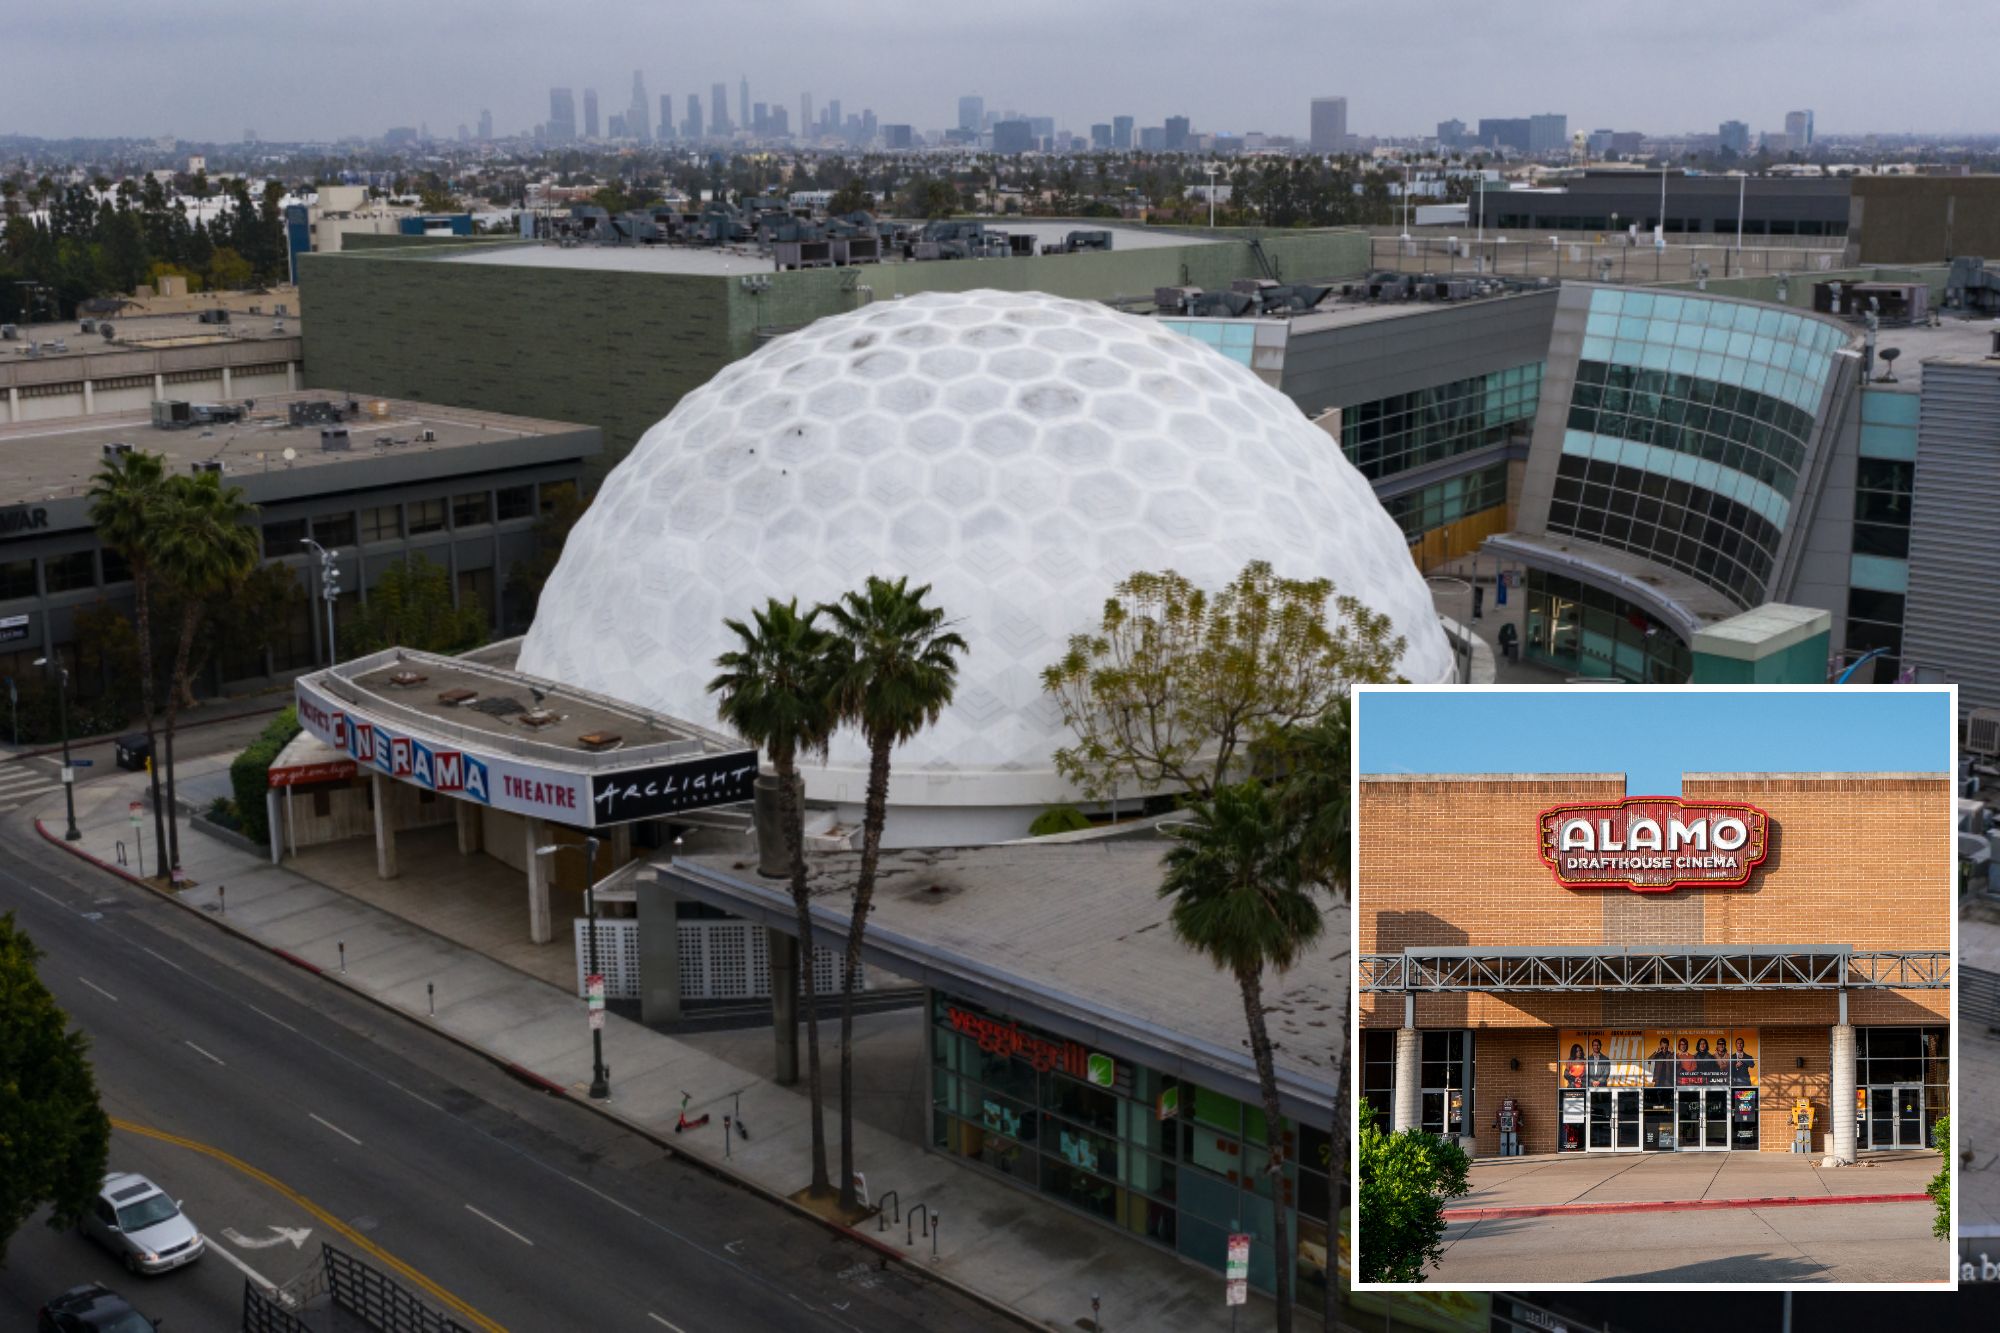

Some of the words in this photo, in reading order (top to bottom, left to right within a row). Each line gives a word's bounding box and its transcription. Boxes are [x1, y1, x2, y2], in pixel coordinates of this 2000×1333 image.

[332, 716, 488, 800] CINERAMA
[503, 775, 576, 809] THEATRE
[594, 765, 751, 815] ARCLIGHT
[1560, 818, 1748, 851] ALAMO
[1567, 857, 1672, 869] DRAFTHOUSE
[1676, 857, 1738, 868] CINEMA
[1609, 1036, 1644, 1061] HIT
